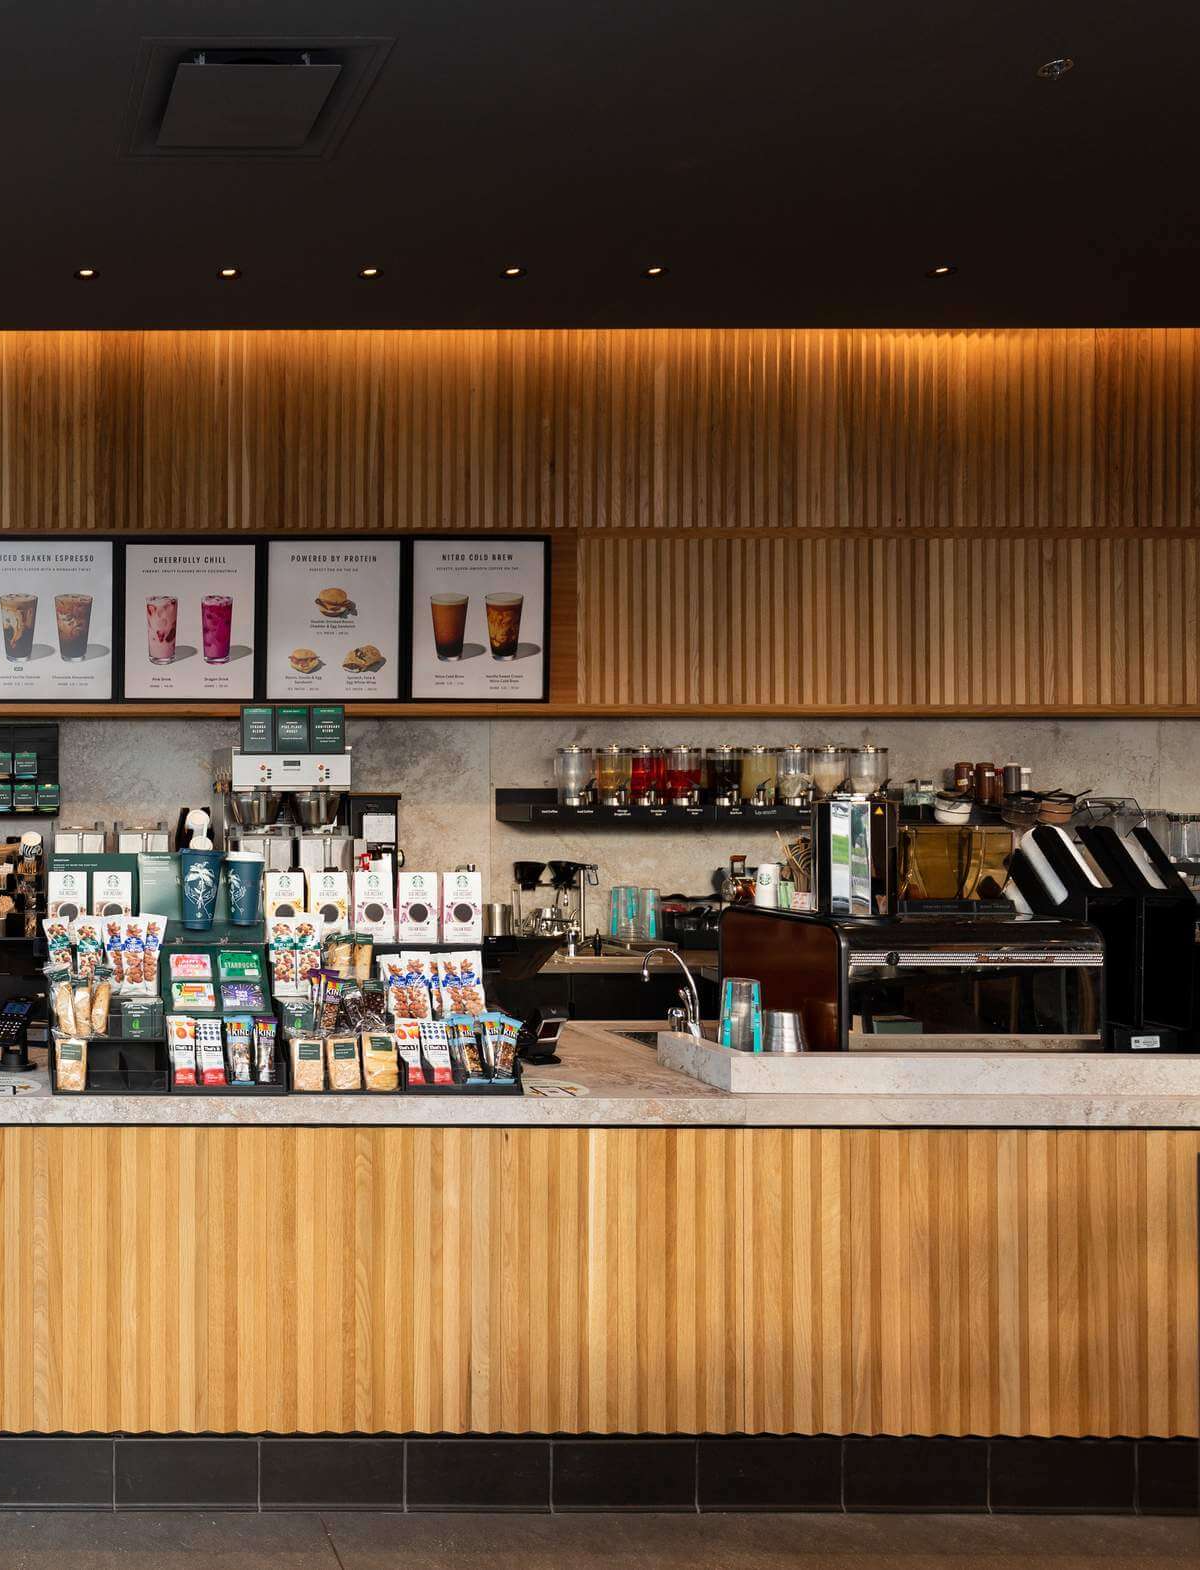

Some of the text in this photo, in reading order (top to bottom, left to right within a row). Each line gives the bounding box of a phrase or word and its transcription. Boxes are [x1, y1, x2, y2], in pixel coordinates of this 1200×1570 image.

[0, 554, 94, 562] ICED SHAKEN ESPRESSO
[153, 556, 226, 564] CHEERFULLY CHILL
[442, 553, 513, 561] NITRO COLD BREW
[224, 961, 257, 969] STARBUCKS
